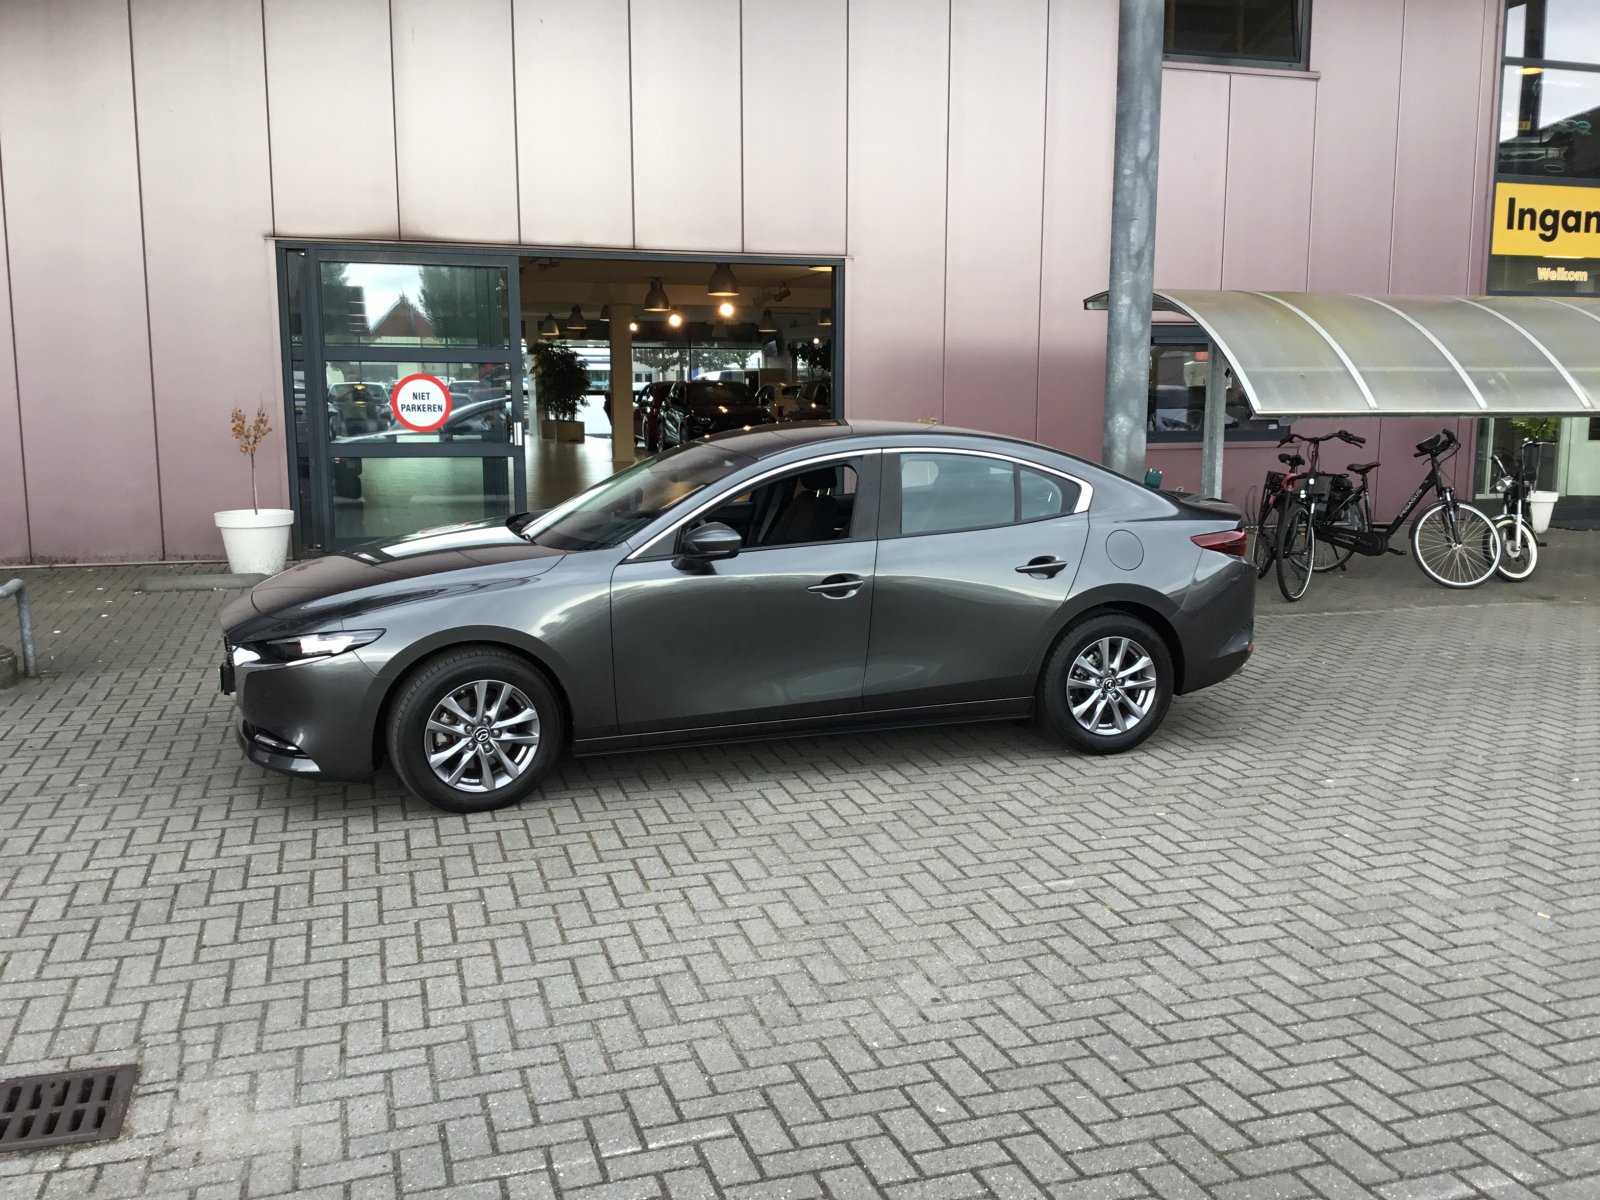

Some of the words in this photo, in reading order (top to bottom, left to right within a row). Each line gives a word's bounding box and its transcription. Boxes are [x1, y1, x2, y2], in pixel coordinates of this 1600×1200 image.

[1506, 197, 1600, 242] Ingan
[1537, 267, 1588, 281] Welkom
[412, 391, 431, 401] NIET
[400, 403, 443, 413] PARKEREN
